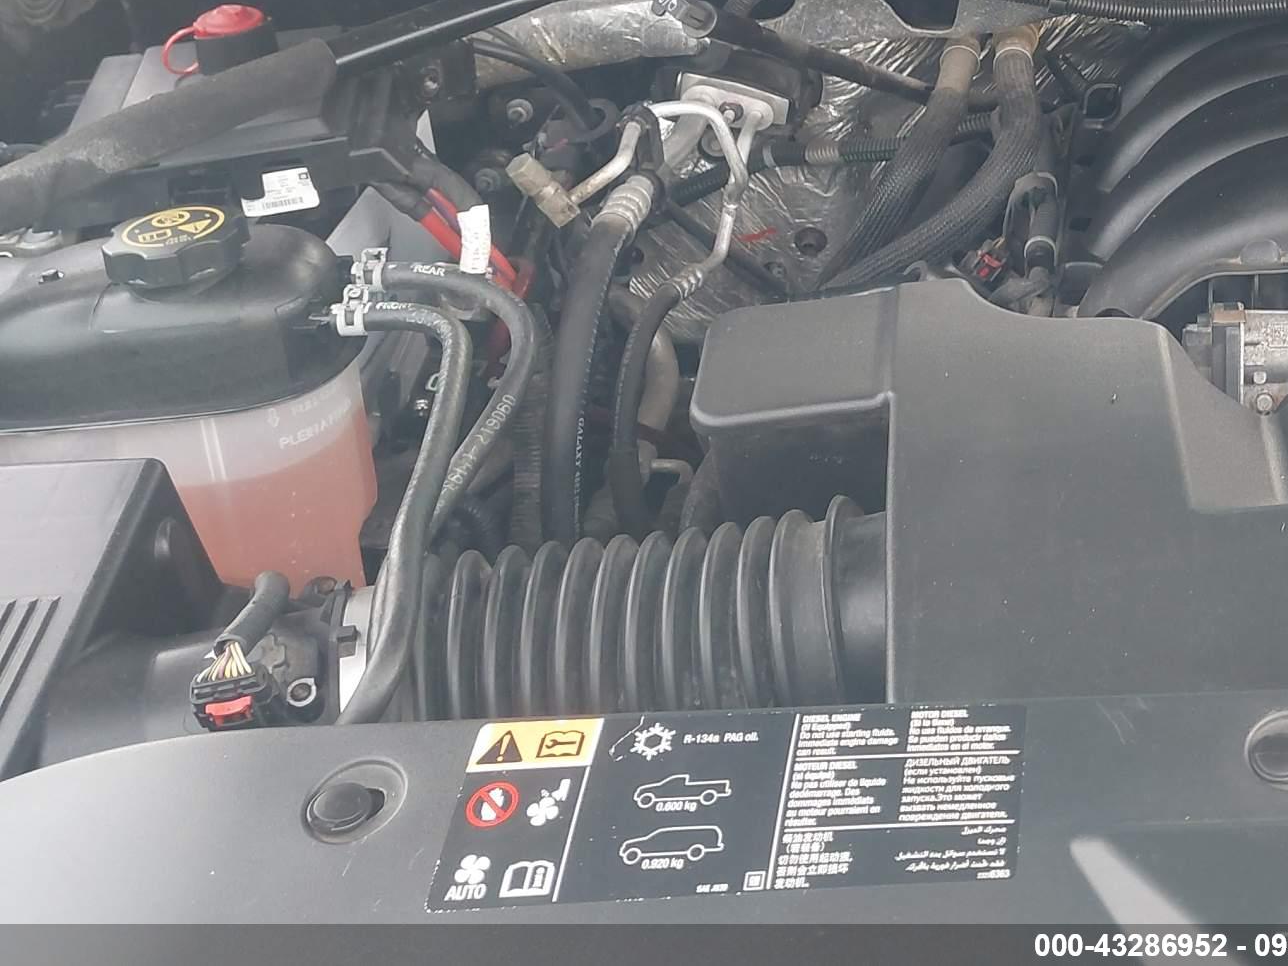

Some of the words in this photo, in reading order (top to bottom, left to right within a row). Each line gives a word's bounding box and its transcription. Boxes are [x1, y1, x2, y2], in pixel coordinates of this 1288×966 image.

[413, 264, 445, 277] REAR
[683, 735, 720, 744] R-134a
[724, 733, 743, 742] PAG
[684, 800, 697, 812] kg
[670, 858, 684, 870] kg
[444, 883, 486, 901] AUTO
